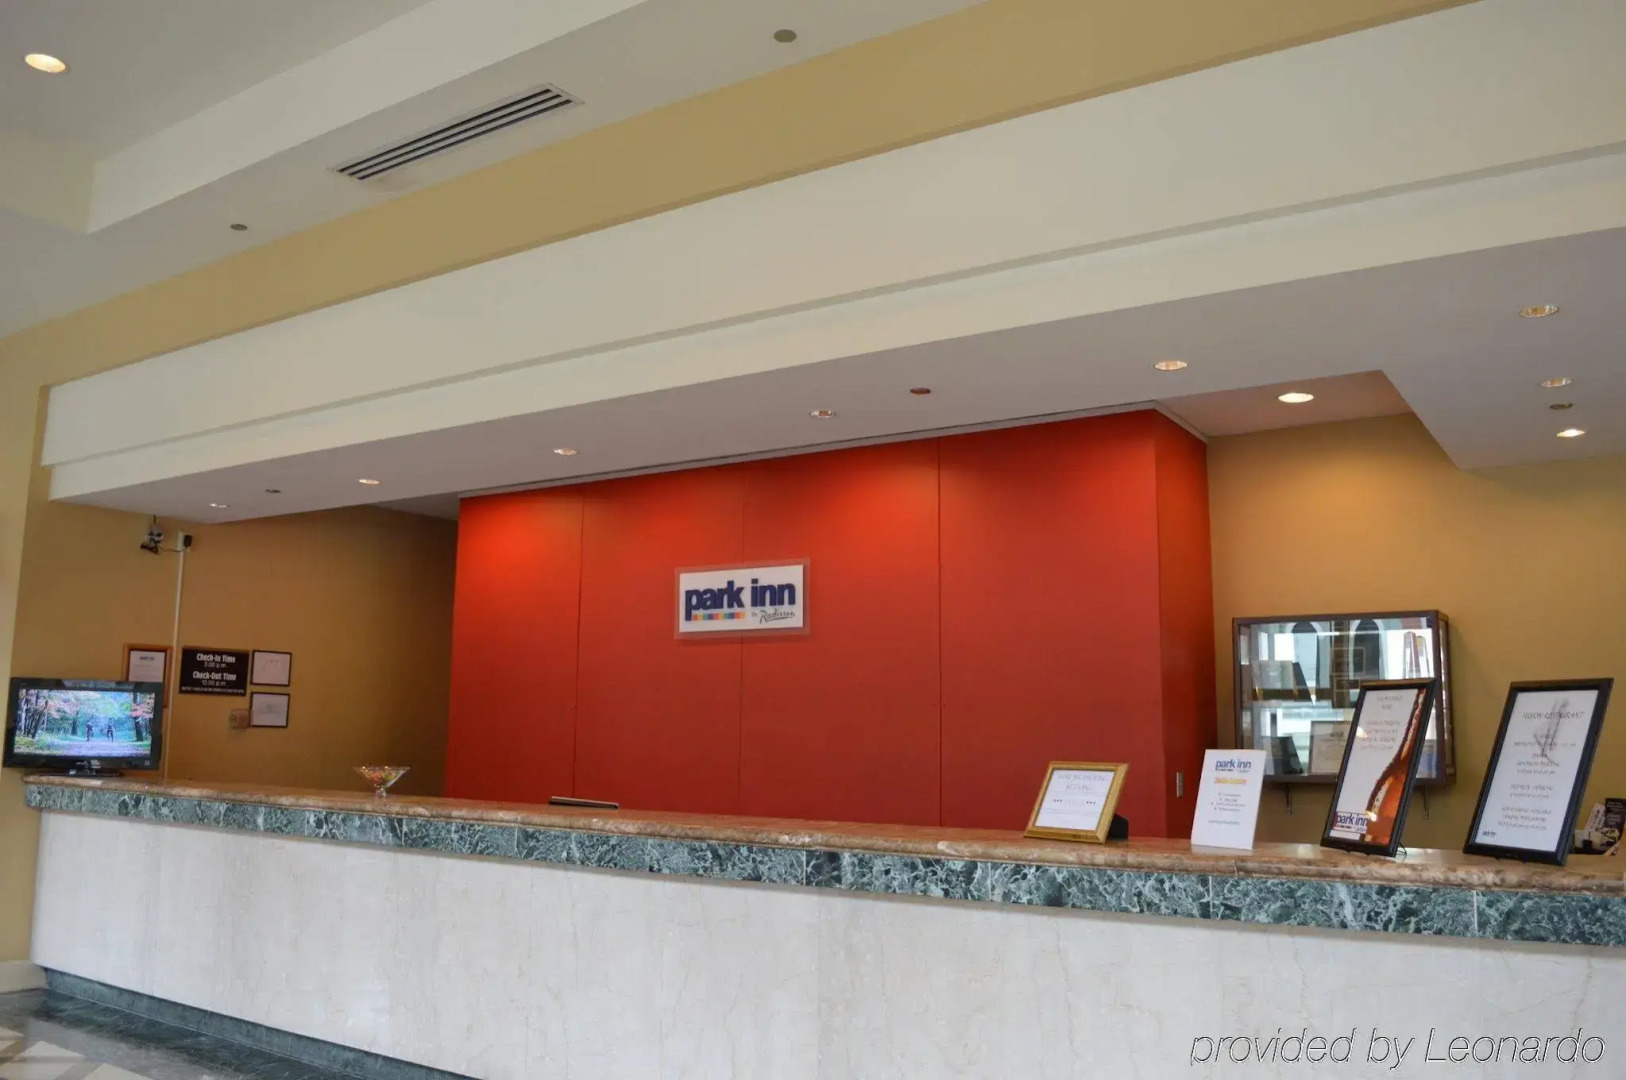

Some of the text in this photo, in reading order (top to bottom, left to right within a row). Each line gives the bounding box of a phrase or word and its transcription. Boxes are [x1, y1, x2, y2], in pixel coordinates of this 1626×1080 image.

[685, 578, 796, 621] park inn
[222, 654, 236, 663] Time
[193, 671, 237, 681] Check-Out Time
[1215, 759, 1236, 772] park
[1237, 759, 1252, 769] inn
[1336, 812, 1354, 826] park
